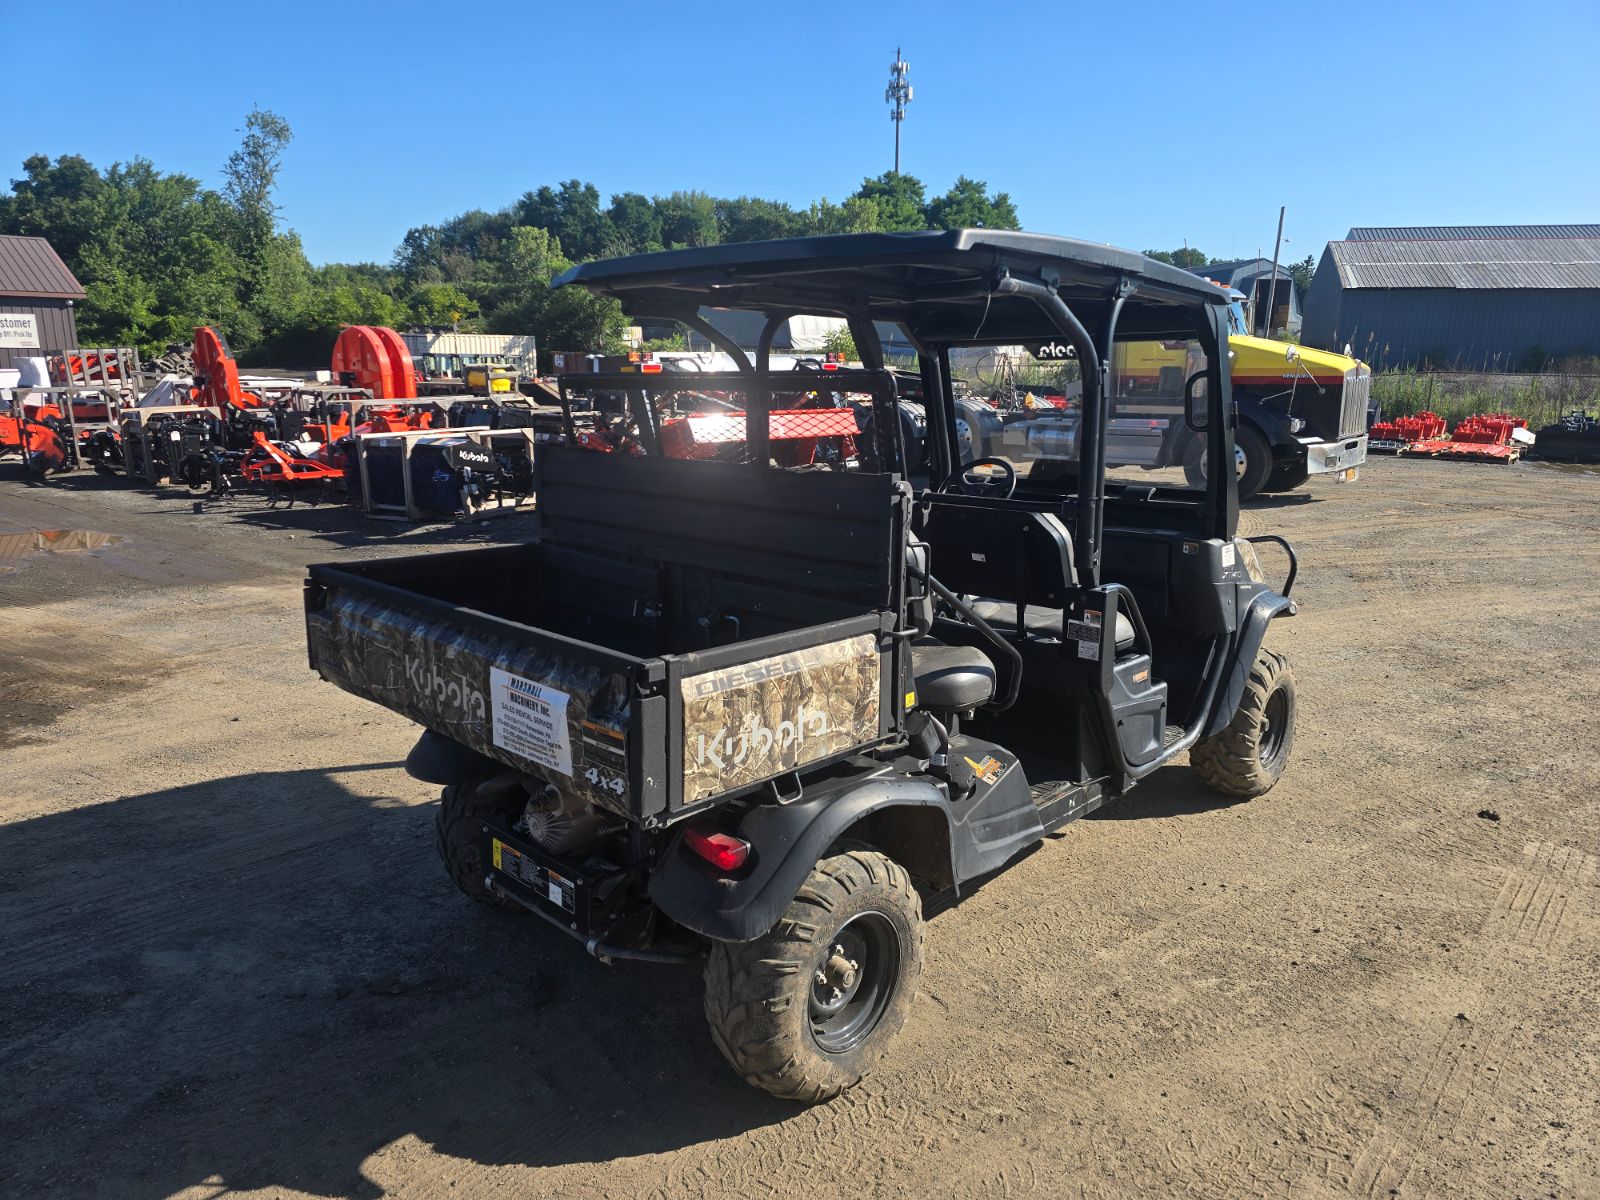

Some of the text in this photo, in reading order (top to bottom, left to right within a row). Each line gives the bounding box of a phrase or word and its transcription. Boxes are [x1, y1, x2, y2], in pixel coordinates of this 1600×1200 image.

[459, 450, 489, 463] Kubota
[405, 654, 485, 719] Kubota
[510, 677, 542, 698] MARSHALL
[695, 660, 799, 696] DIESEL
[501, 702, 516, 714] SALES
[516, 706, 533, 722] RENTAL
[533, 715, 553, 731] SERVICE
[697, 706, 827, 769] Kubota
[584, 767, 625, 796] 4x4
